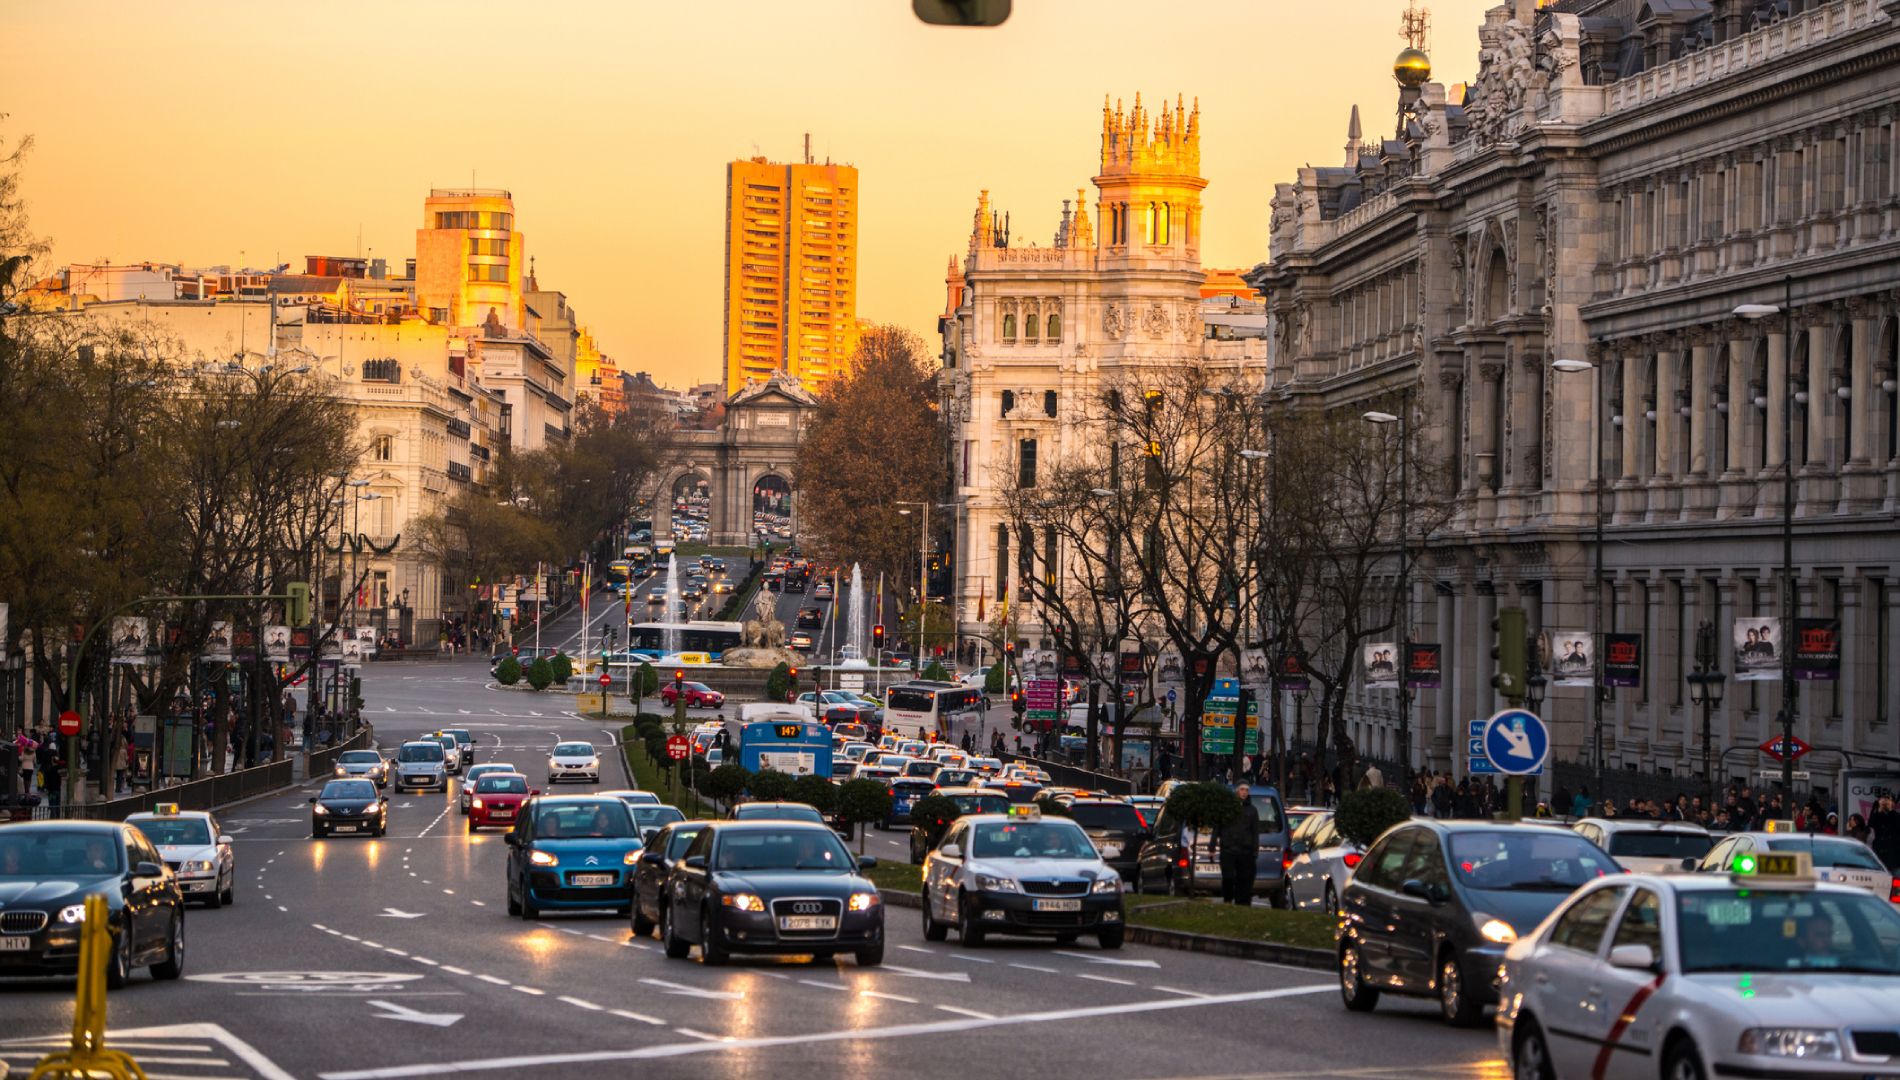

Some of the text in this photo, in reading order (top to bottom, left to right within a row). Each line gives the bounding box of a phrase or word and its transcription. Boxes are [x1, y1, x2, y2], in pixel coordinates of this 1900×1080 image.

[781, 726, 796, 737] 147
[1757, 855, 1797, 873] TAXI
[6, 937, 28, 948] HTV
